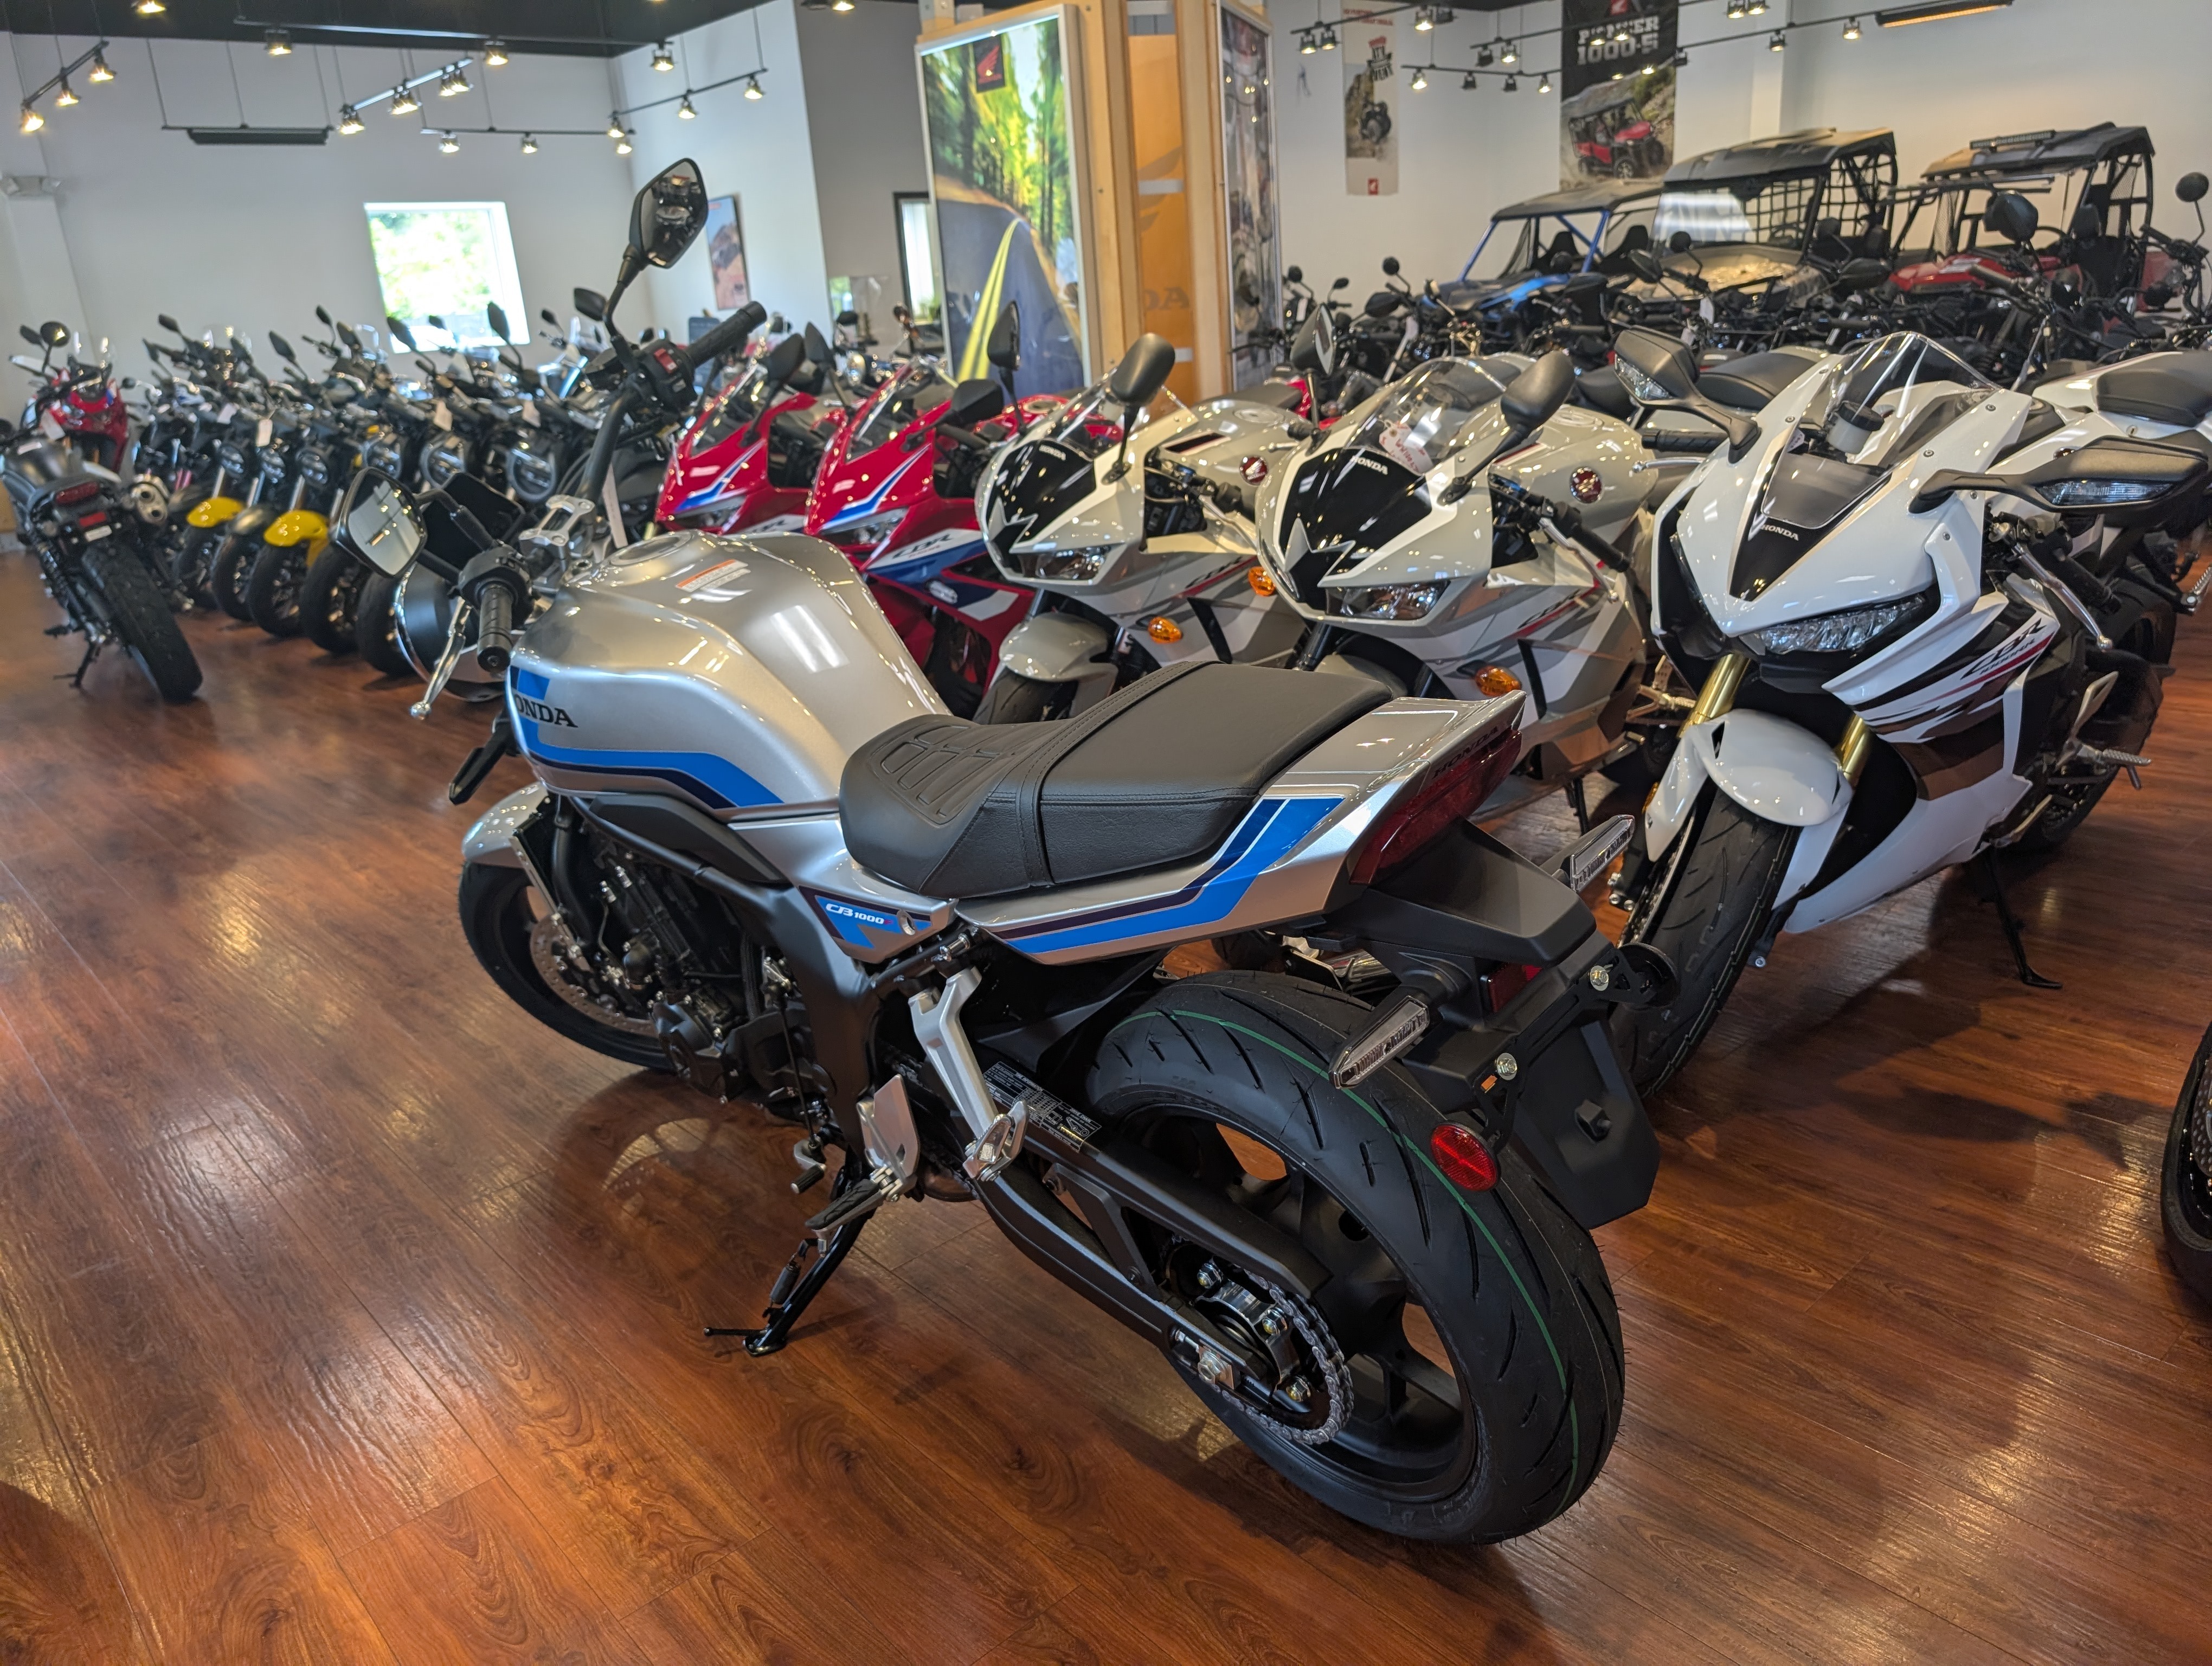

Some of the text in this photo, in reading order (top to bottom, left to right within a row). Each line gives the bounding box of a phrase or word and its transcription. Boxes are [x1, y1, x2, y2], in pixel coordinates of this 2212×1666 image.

[1351, 456, 1388, 475] HONDA
[1760, 524, 1799, 541] HONDA
[1960, 617, 2047, 681] CBR
[1431, 726, 1499, 780] HONDA
